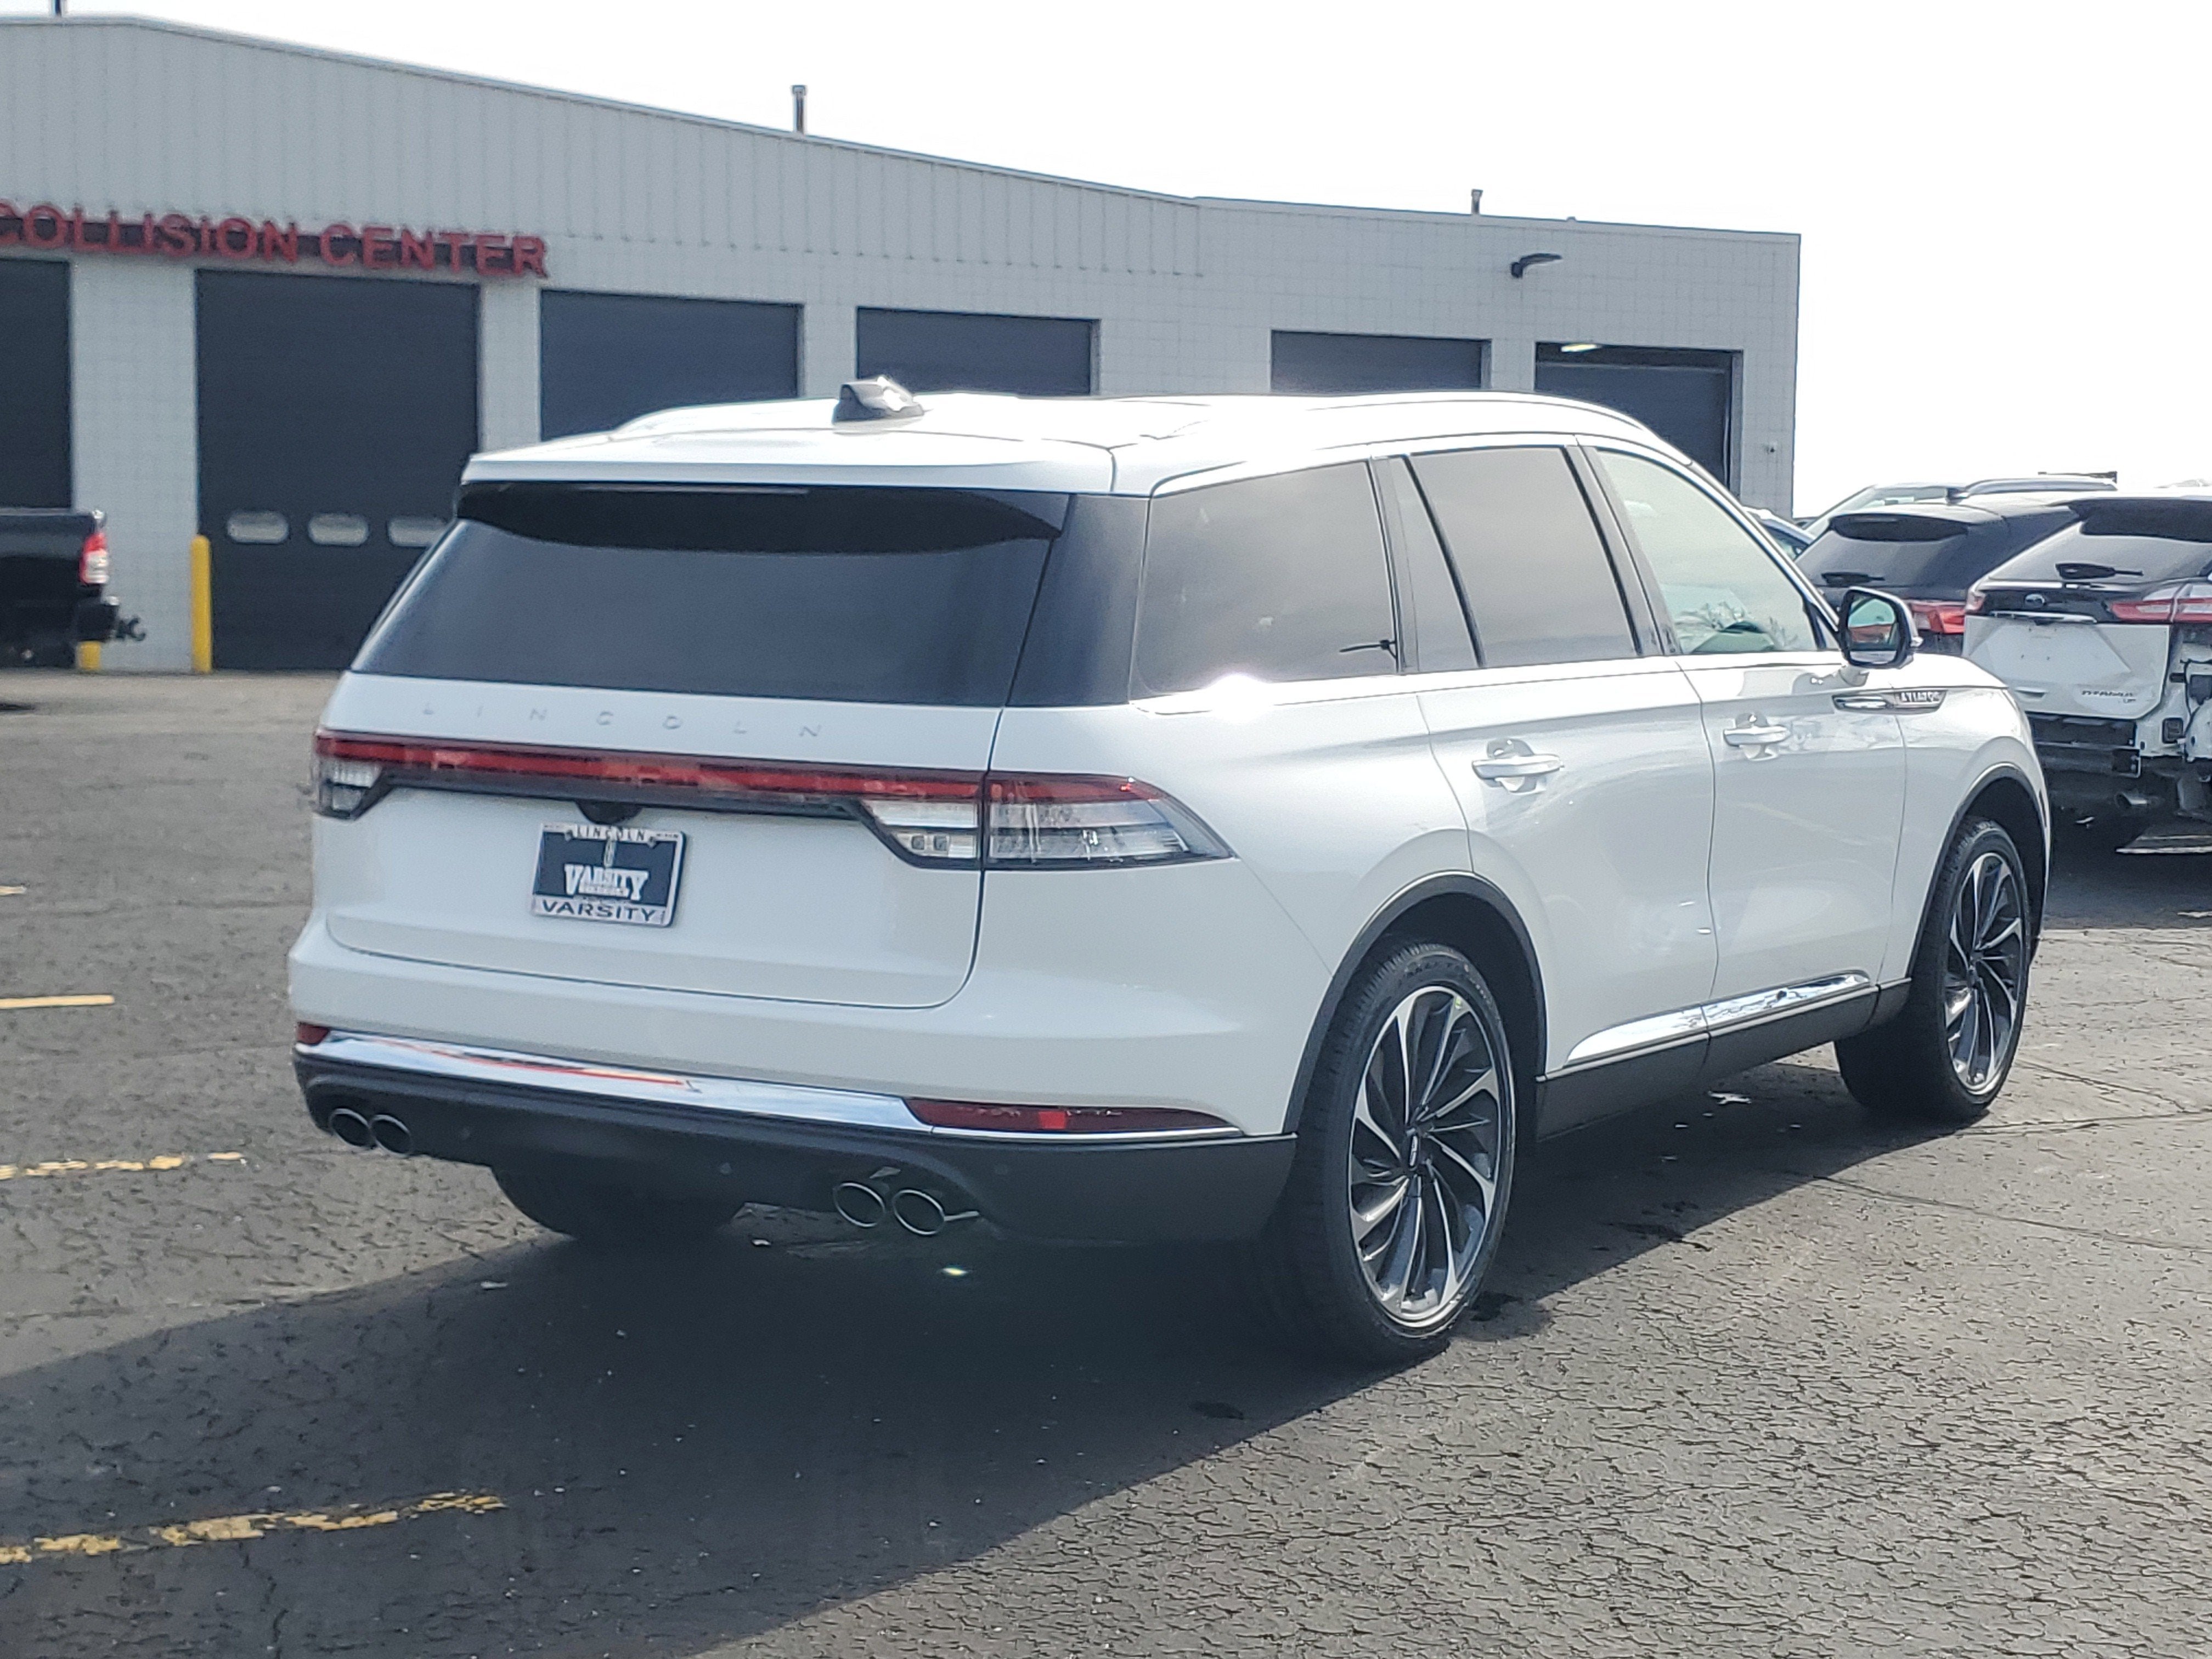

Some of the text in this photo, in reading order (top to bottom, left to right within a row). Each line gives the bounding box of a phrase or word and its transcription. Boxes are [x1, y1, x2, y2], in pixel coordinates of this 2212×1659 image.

[319, 224, 548, 278] CENTER
[422, 703, 822, 737] LINCOLN
[564, 864, 649, 901] VARSITY
[543, 900, 656, 922] VARSITY
